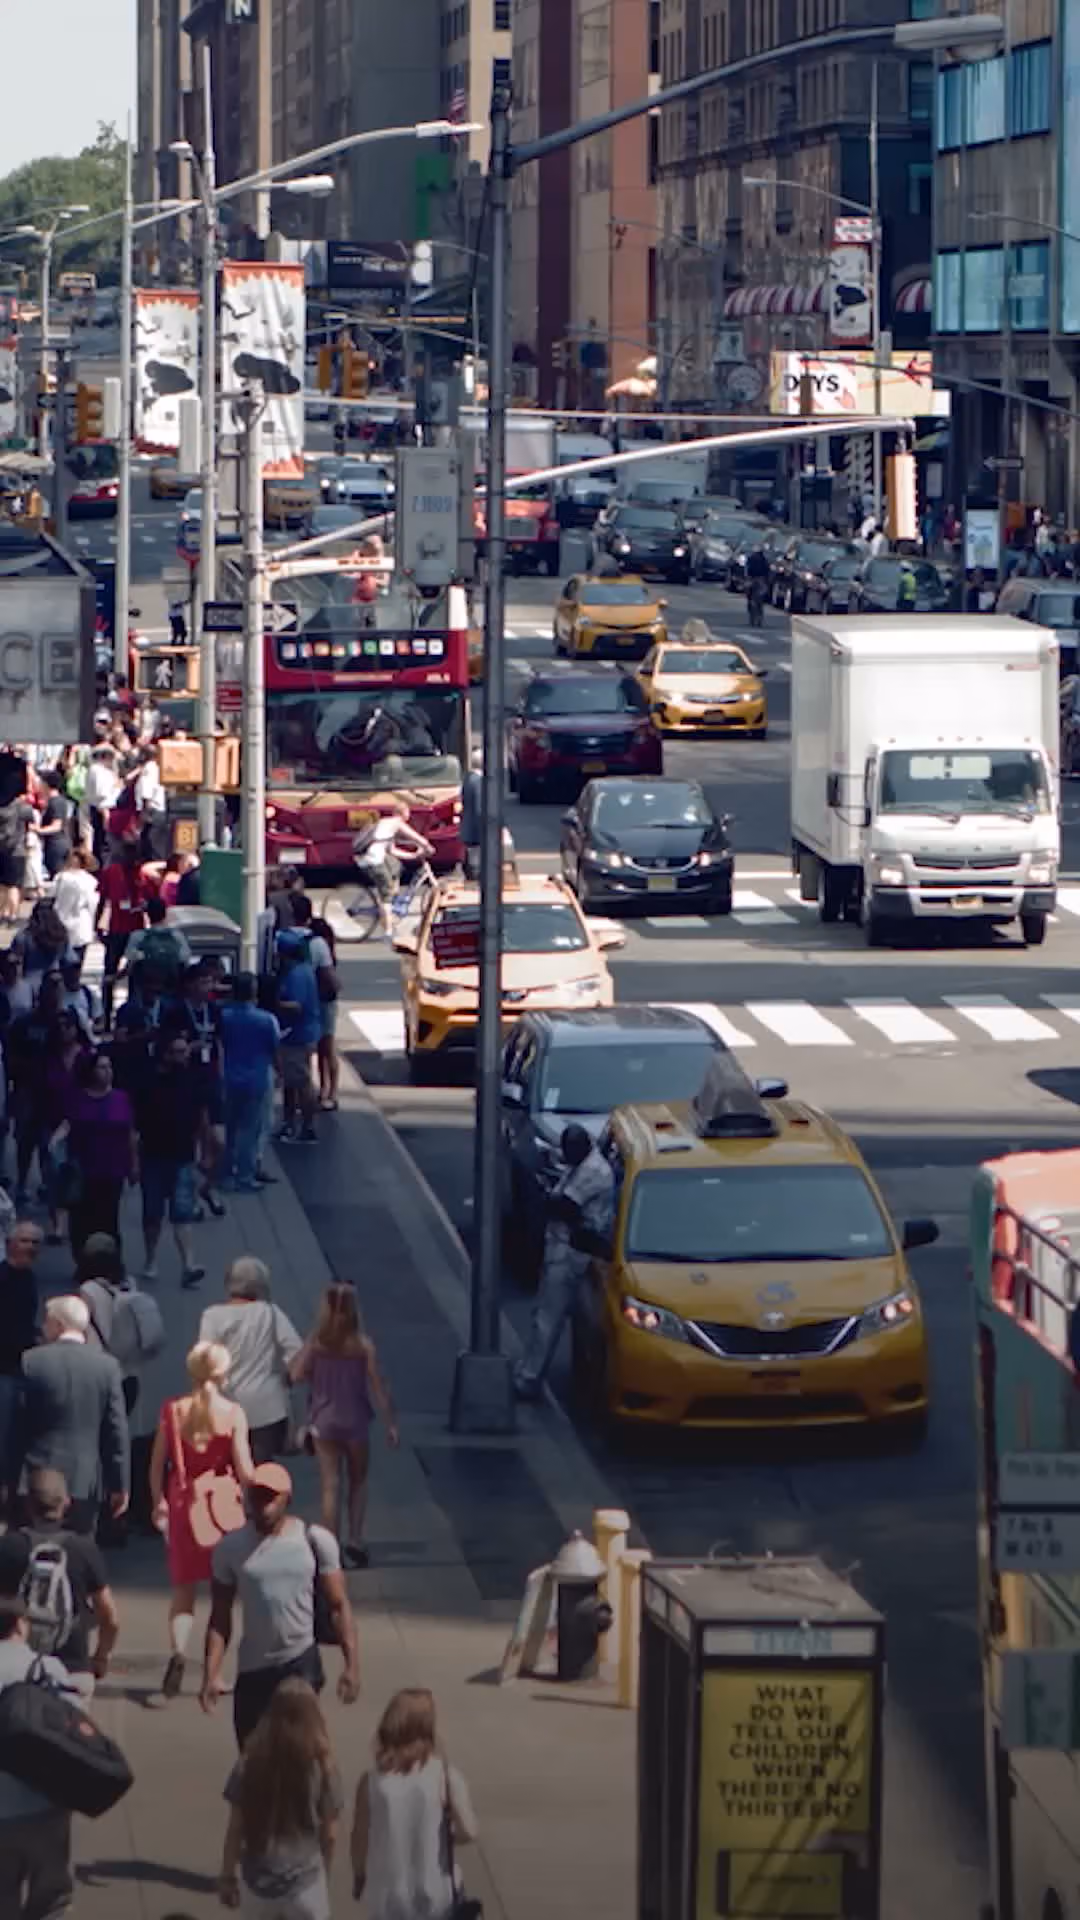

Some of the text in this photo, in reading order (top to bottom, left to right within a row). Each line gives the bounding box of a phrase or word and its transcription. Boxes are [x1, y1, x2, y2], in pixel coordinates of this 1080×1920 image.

[783, 374, 841, 393] DYS
[756, 1685, 826, 1702] WHAT
[750, 1704, 833, 1721] DO WE
[733, 1723, 848, 1740] TELL OUR
[728, 1743, 850, 1760] CHILDREN
[753, 1762, 826, 1779] WHEN
[718, 1781, 861, 1799] THERE'S NO
